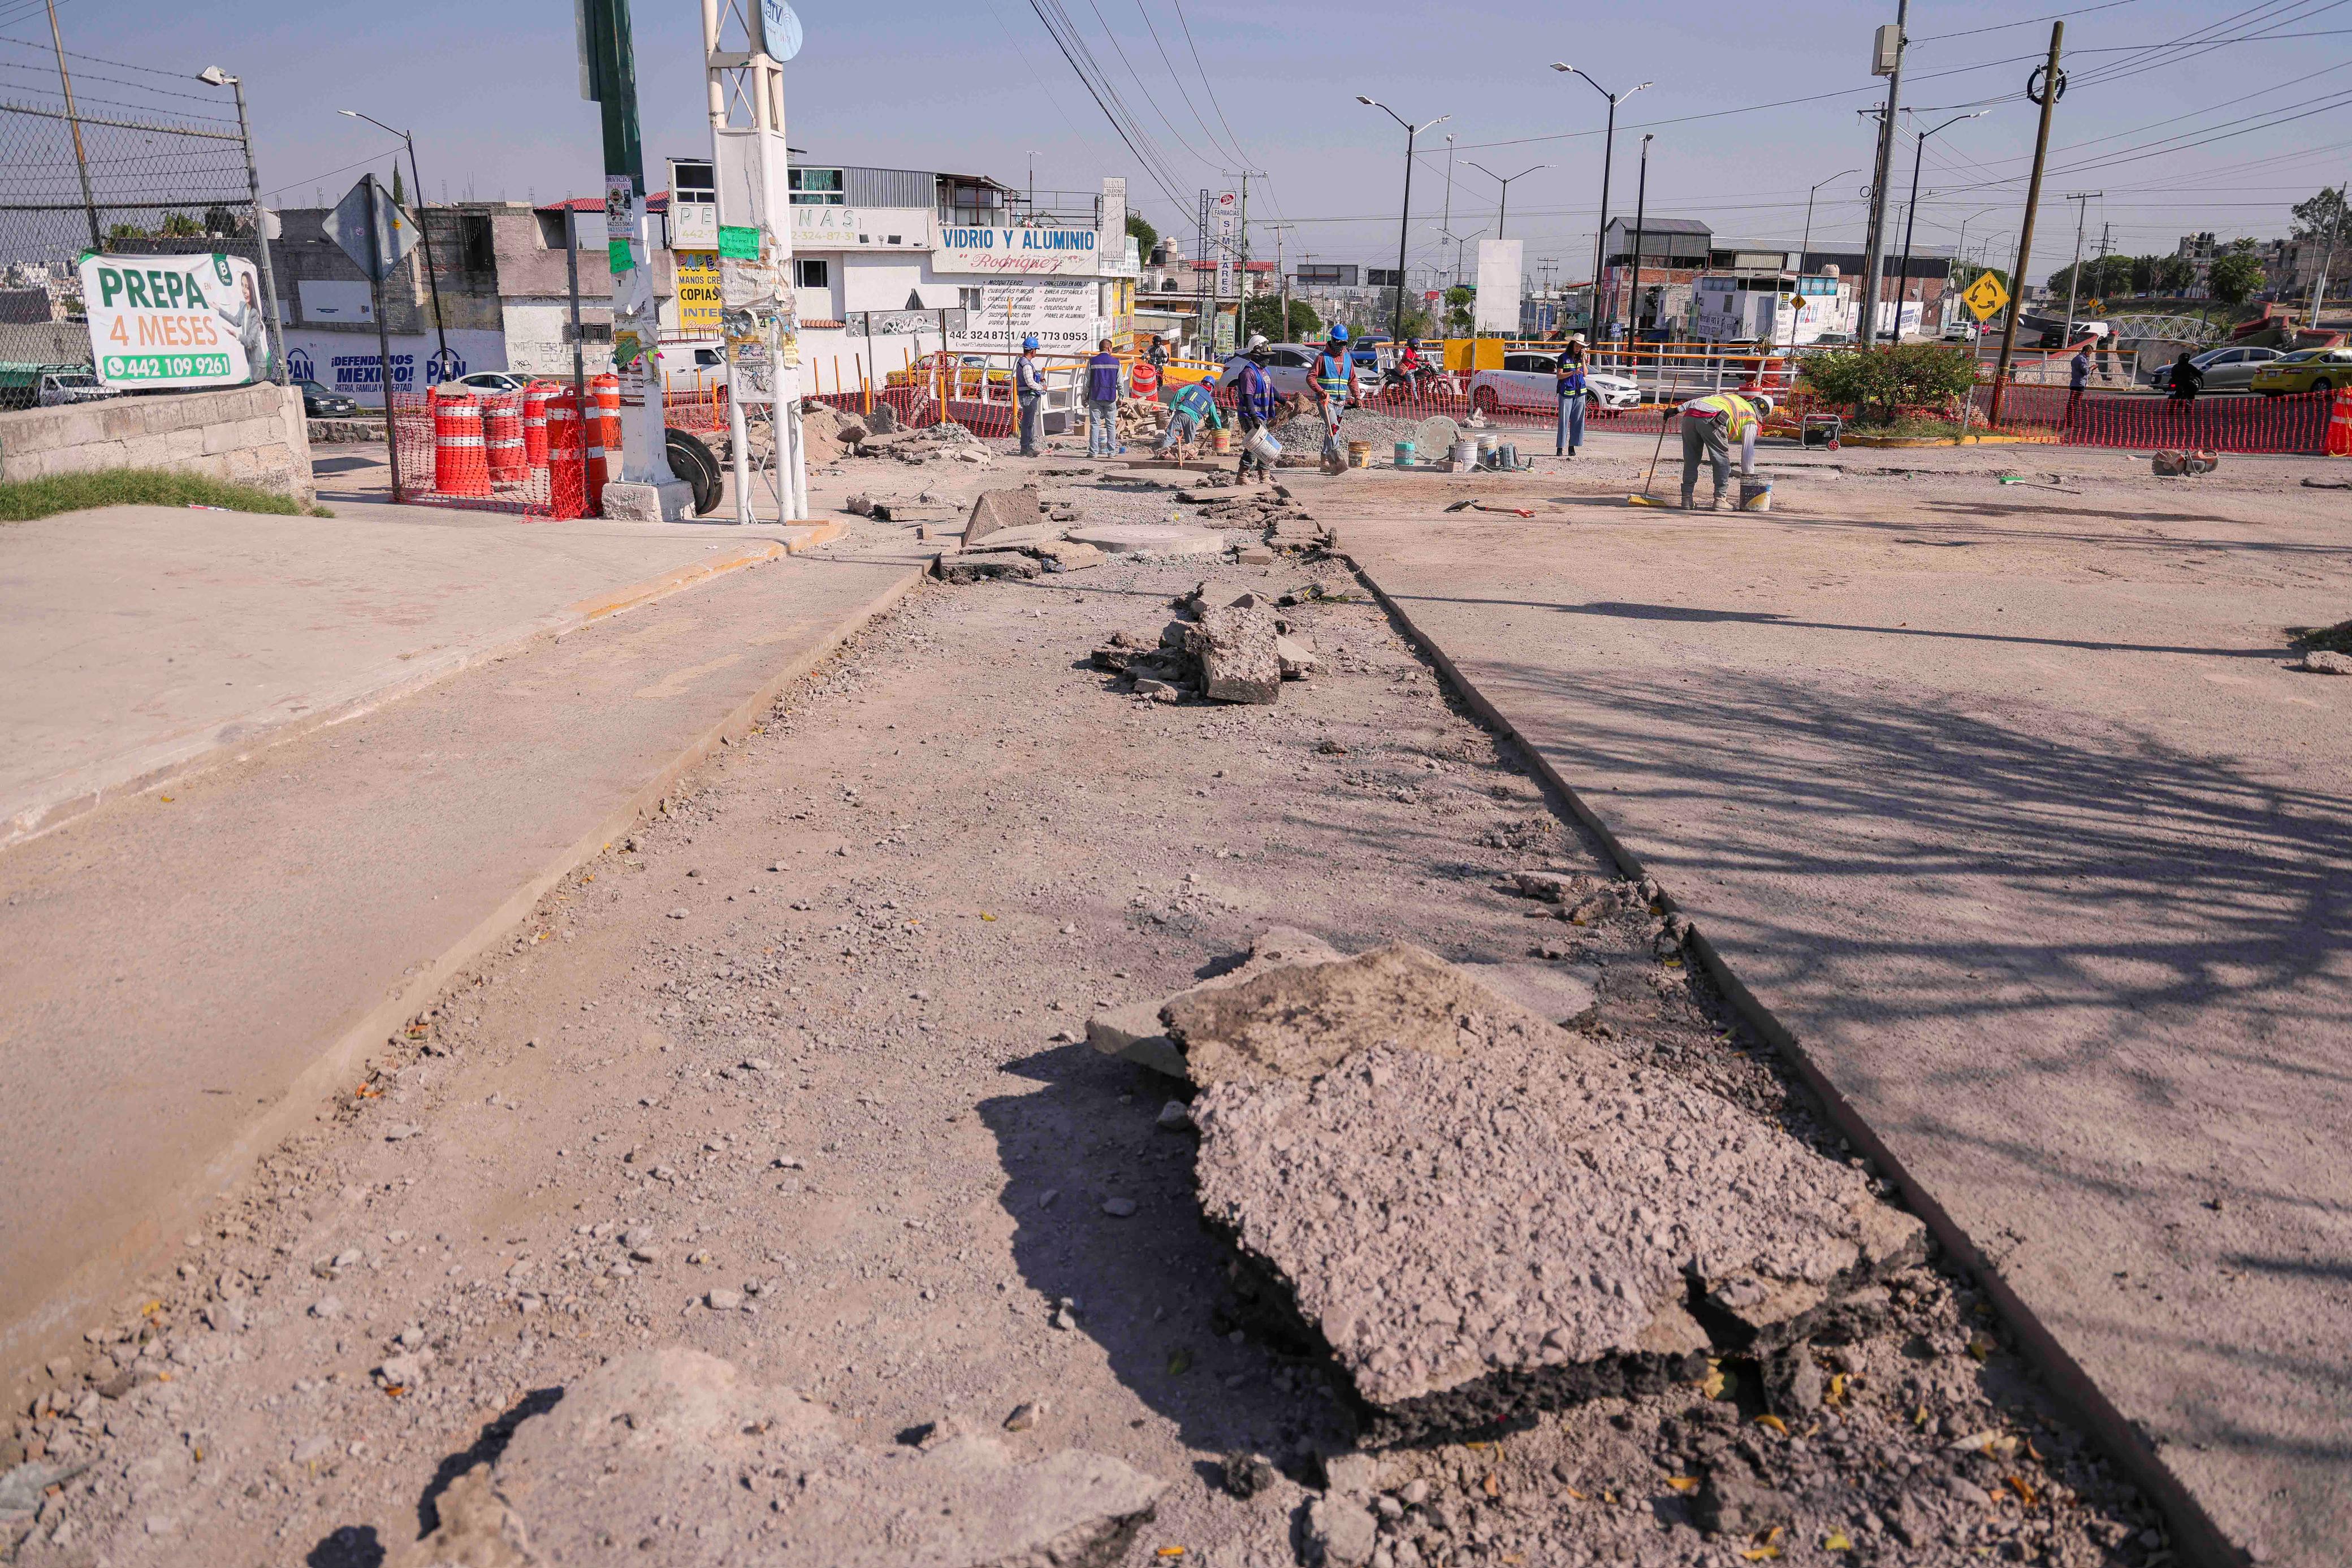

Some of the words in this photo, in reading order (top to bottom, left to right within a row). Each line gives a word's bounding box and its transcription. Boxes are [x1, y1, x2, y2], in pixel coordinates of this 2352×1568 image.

[1104, 179, 1125, 188] RENTA
[943, 229, 993, 248] VIDRIO
[1003, 230, 1013, 249] Y
[1022, 230, 1095, 250] ALUMINIO
[1221, 220, 1231, 293] SIMILARES
[97, 267, 209, 309] PREPA
[204, 282, 211, 291] EN
[678, 276, 704, 284] MANOS
[707, 276, 721, 284] CRE
[680, 288, 719, 301] COPIAS
[110, 315, 129, 346] 4
[138, 315, 218, 346] MESES
[950, 331, 967, 339] 442
[1041, 332, 1060, 340] 773
[1063, 332, 1088, 341] 0953
[127, 358, 161, 376] 442
[165, 358, 192, 376] 109
[195, 357, 229, 375] 9261
[426, 359, 466, 384] PAN
[335, 383, 355, 393] PATRIA,
[356, 384, 378, 393] FAMILIA
[378, 384, 383, 392] Y
